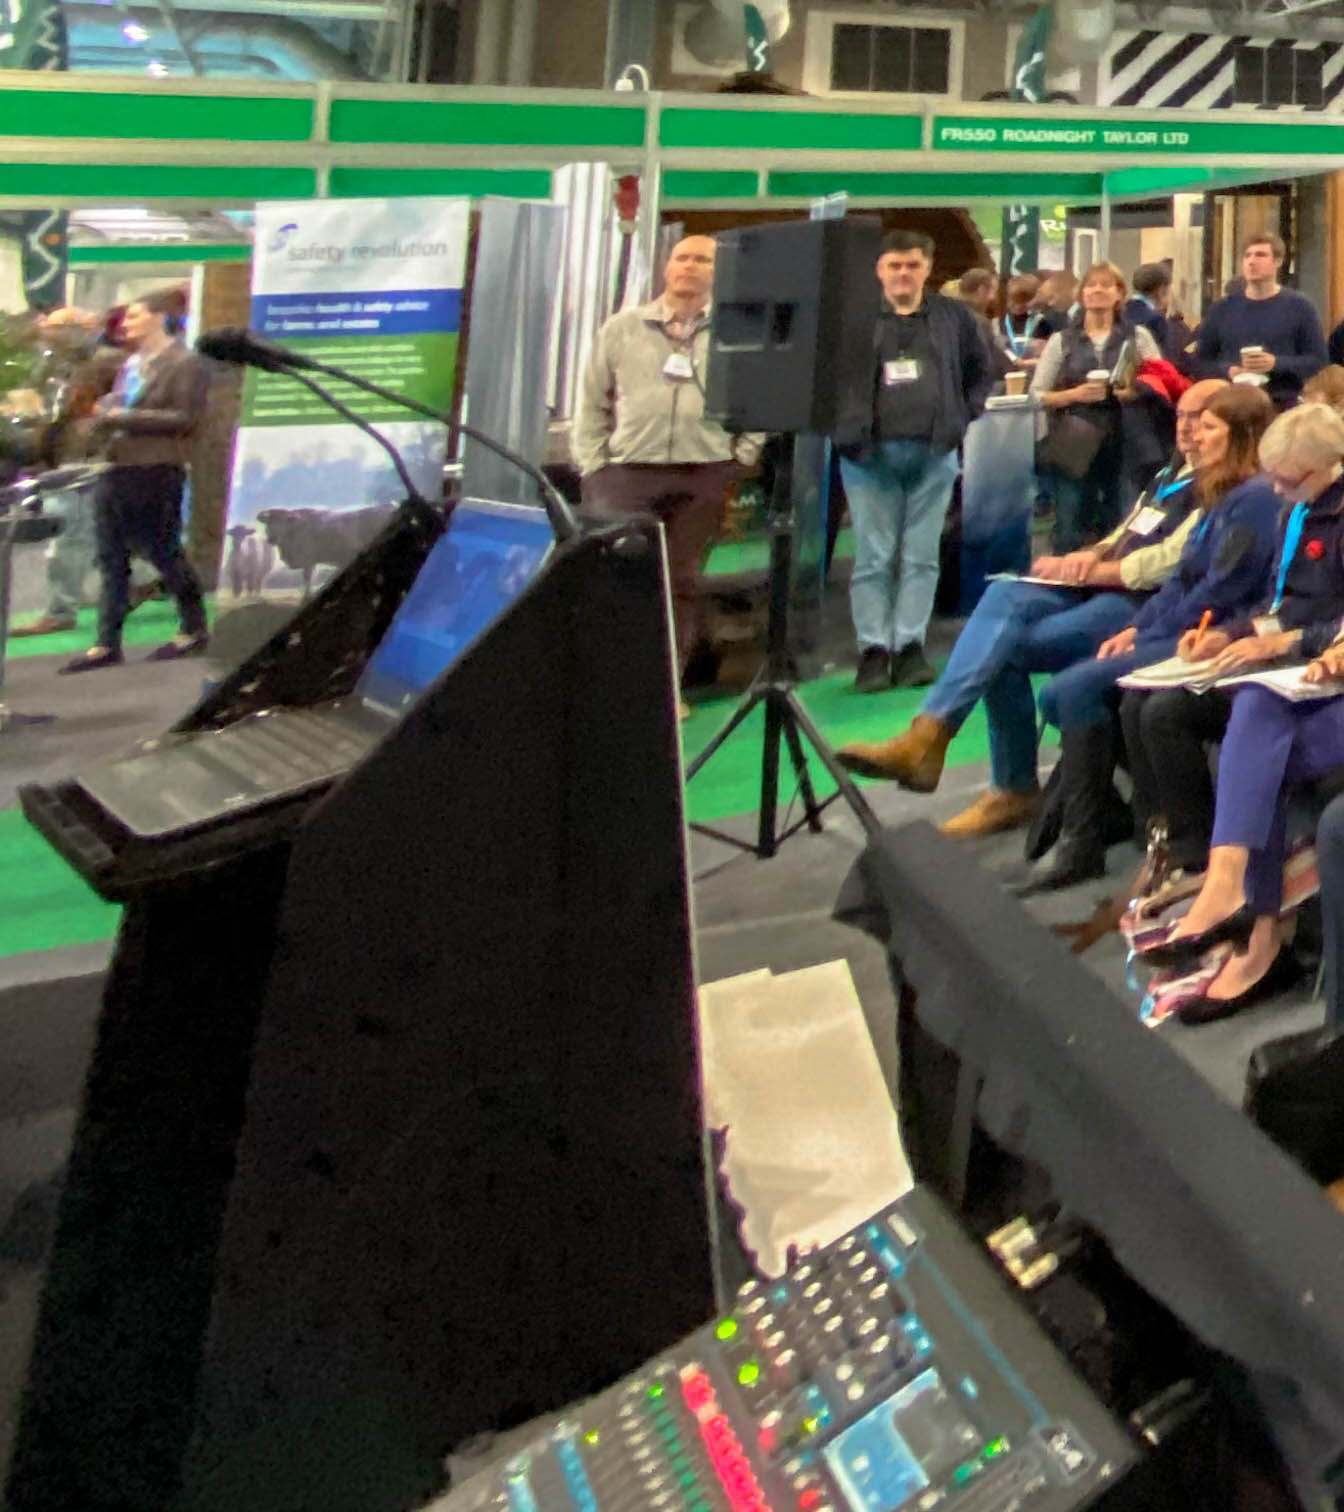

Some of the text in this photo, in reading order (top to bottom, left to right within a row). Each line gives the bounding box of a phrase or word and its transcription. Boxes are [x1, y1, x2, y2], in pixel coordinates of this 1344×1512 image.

[940, 126, 1189, 145] FR550 ROADNIGHT TAYLOR LTD
[287, 240, 447, 262] safety revolution
